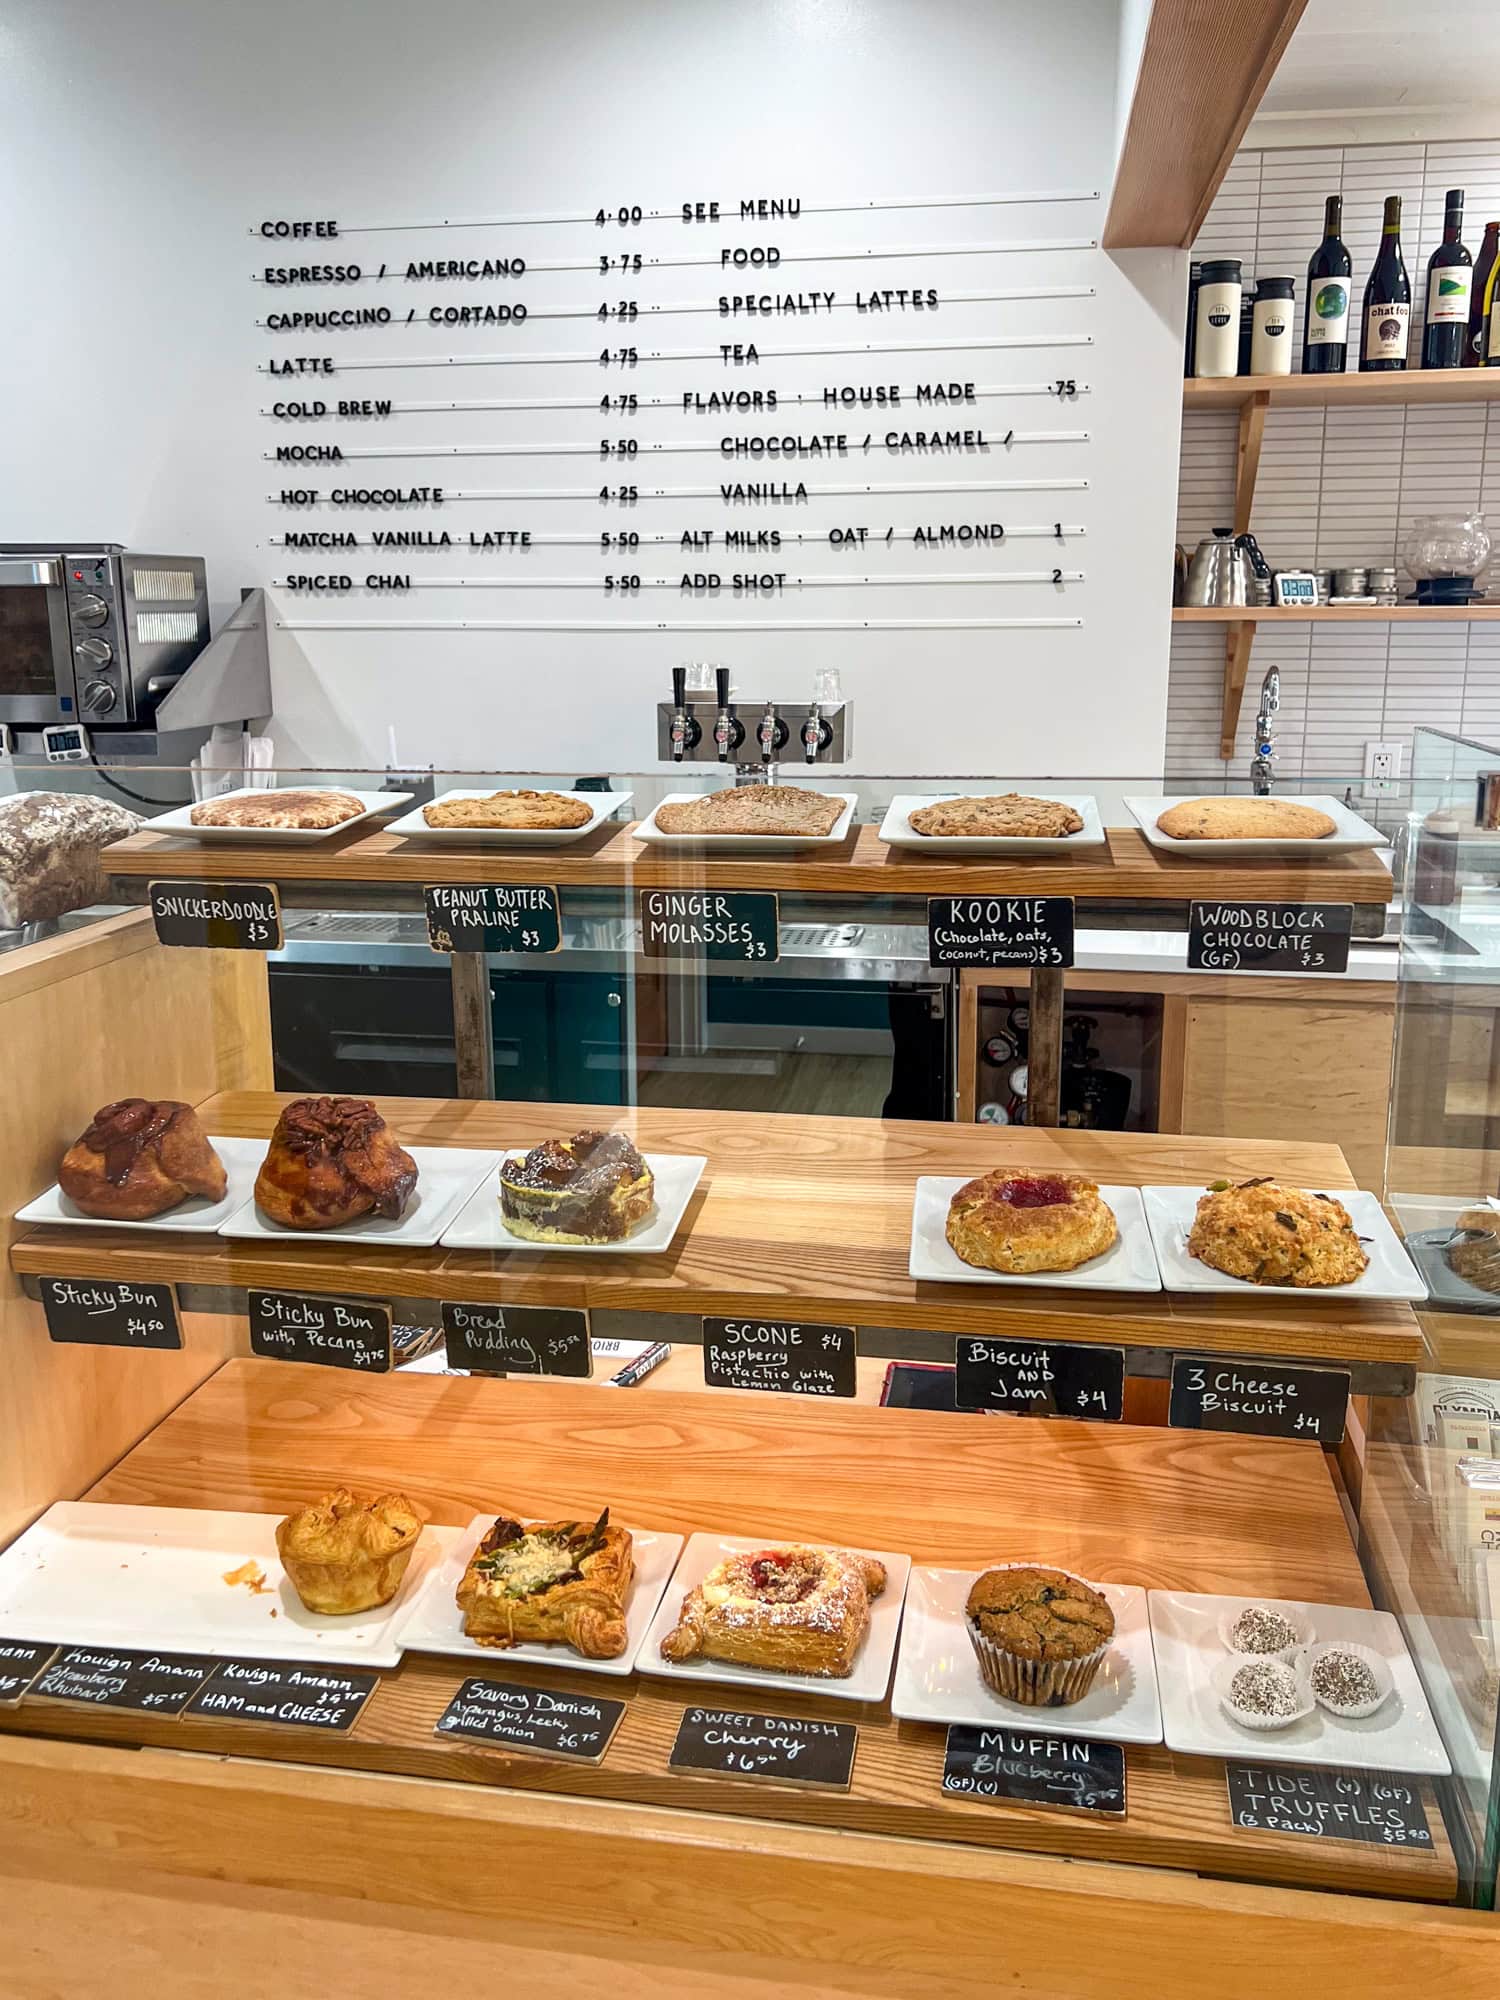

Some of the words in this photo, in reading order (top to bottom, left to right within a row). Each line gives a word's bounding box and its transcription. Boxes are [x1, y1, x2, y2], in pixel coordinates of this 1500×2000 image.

[682, 202, 720, 220] SEE
[740, 198, 800, 217] MENU
[261, 221, 339, 238] COFFEE
[721, 247, 780, 265] FOOD
[265, 264, 361, 285] ESPRESSO
[406, 258, 526, 279] AMERICANO
[719, 292, 835, 313] SPECIALTY
[856, 289, 937, 308] LATTES
[267, 307, 391, 330] CAPPUCCINO
[429, 303, 527, 323] CORTADO
[719, 343, 759, 361] TEA
[270, 358, 334, 375] LATTE
[683, 390, 777, 409] FLAVORS
[823, 385, 900, 403] HOUSE
[916, 383, 975, 401] MADE
[273, 401, 326, 418] COLD
[338, 400, 391, 416] BREW
[276, 445, 344, 461] MOCHA
[721, 435, 848, 453] CHOCOLATE
[885, 430, 988, 448] CARAMEL
[281, 489, 319, 505] HOT
[331, 487, 444, 505] CHOCOLATE
[720, 482, 808, 500] VANILLA
[284, 532, 358, 548] MATCHA
[372, 531, 452, 546] VANILLA
[470, 531, 532, 547] LATTE
[680, 530, 713, 546] ALT
[725, 530, 781, 546] MILKS
[829, 527, 868, 544] OAT
[913, 524, 1004, 542] ALMOND
[1054, 523, 1062, 538] 1
[286, 575, 352, 591] SPICED
[366, 574, 411, 589] CHAI
[680, 573, 721, 589] ADD
[732, 573, 786, 590] SHOT
[1052, 569, 1062, 584] 2
[156, 896, 278, 921] SNICKERDOODLE
[432, 888, 489, 908] PEANUT
[494, 888, 553, 910] BUTTER
[648, 893, 733, 918] GINGER
[450, 908, 520, 928] PRALINE
[950, 900, 1047, 924] KOOKIE
[247, 922, 269, 942] $3
[521, 929, 540, 947] $3
[650, 920, 754, 944] MOLASSES
[1015, 927, 1053, 944] oats,
[1202, 931, 1313, 951] CHOCOLATE
[744, 941, 767, 959] $3
[1039, 945, 1064, 964] $3
[1200, 949, 1241, 969] (GF)
[1300, 952, 1326, 967] $3
[52, 1282, 118, 1316] Sticky
[118, 1285, 158, 1308] Bun
[260, 1297, 325, 1330] Sticky
[333, 1306, 374, 1330] Bun
[453, 1307, 506, 1329] Bread
[262, 1328, 296, 1347] with
[305, 1330, 366, 1351] Pecans
[464, 1329, 538, 1364] Pudding
[724, 1323, 803, 1346] SCONE
[821, 1333, 842, 1351] $4
[709, 1345, 789, 1368] Raspberry
[967, 1342, 1051, 1370] Biscuit
[711, 1361, 790, 1380] Pistachio
[799, 1368, 836, 1383] with
[1017, 1369, 1055, 1382] AND
[1186, 1368, 1207, 1392] 3
[1214, 1372, 1299, 1398] Cheese
[731, 1377, 782, 1391] Lemon
[792, 1380, 836, 1394] Glaze
[990, 1379, 1048, 1401] Jam
[1076, 1389, 1108, 1412] $4
[1199, 1392, 1288, 1416] Biscuit
[1292, 1412, 1321, 1435] $4
[44, 1664, 129, 1695] Strawberry
[139, 1656, 204, 1680] Amann
[38, 1679, 110, 1702] Rhubarb
[287, 1671, 353, 1691] Amann
[200, 1692, 246, 1712] HAM
[245, 1703, 277, 1715] and
[278, 1702, 346, 1724] CHEESE
[466, 1682, 530, 1711] Savory
[534, 1693, 602, 1721] Danish
[493, 1724, 535, 1740] onion
[690, 1709, 754, 1728] SWEET
[764, 1719, 839, 1738] DANISH
[703, 1729, 807, 1760] Cherry
[979, 1731, 1091, 1763] MUFFIN
[971, 1753, 1086, 1792] Blueberry
[1236, 1768, 1316, 1796] TIDE
[1373, 1782, 1413, 1805] (GF)
[1239, 1809, 1260, 1828] (3
[1243, 1792, 1406, 1829] TRUFFLES
